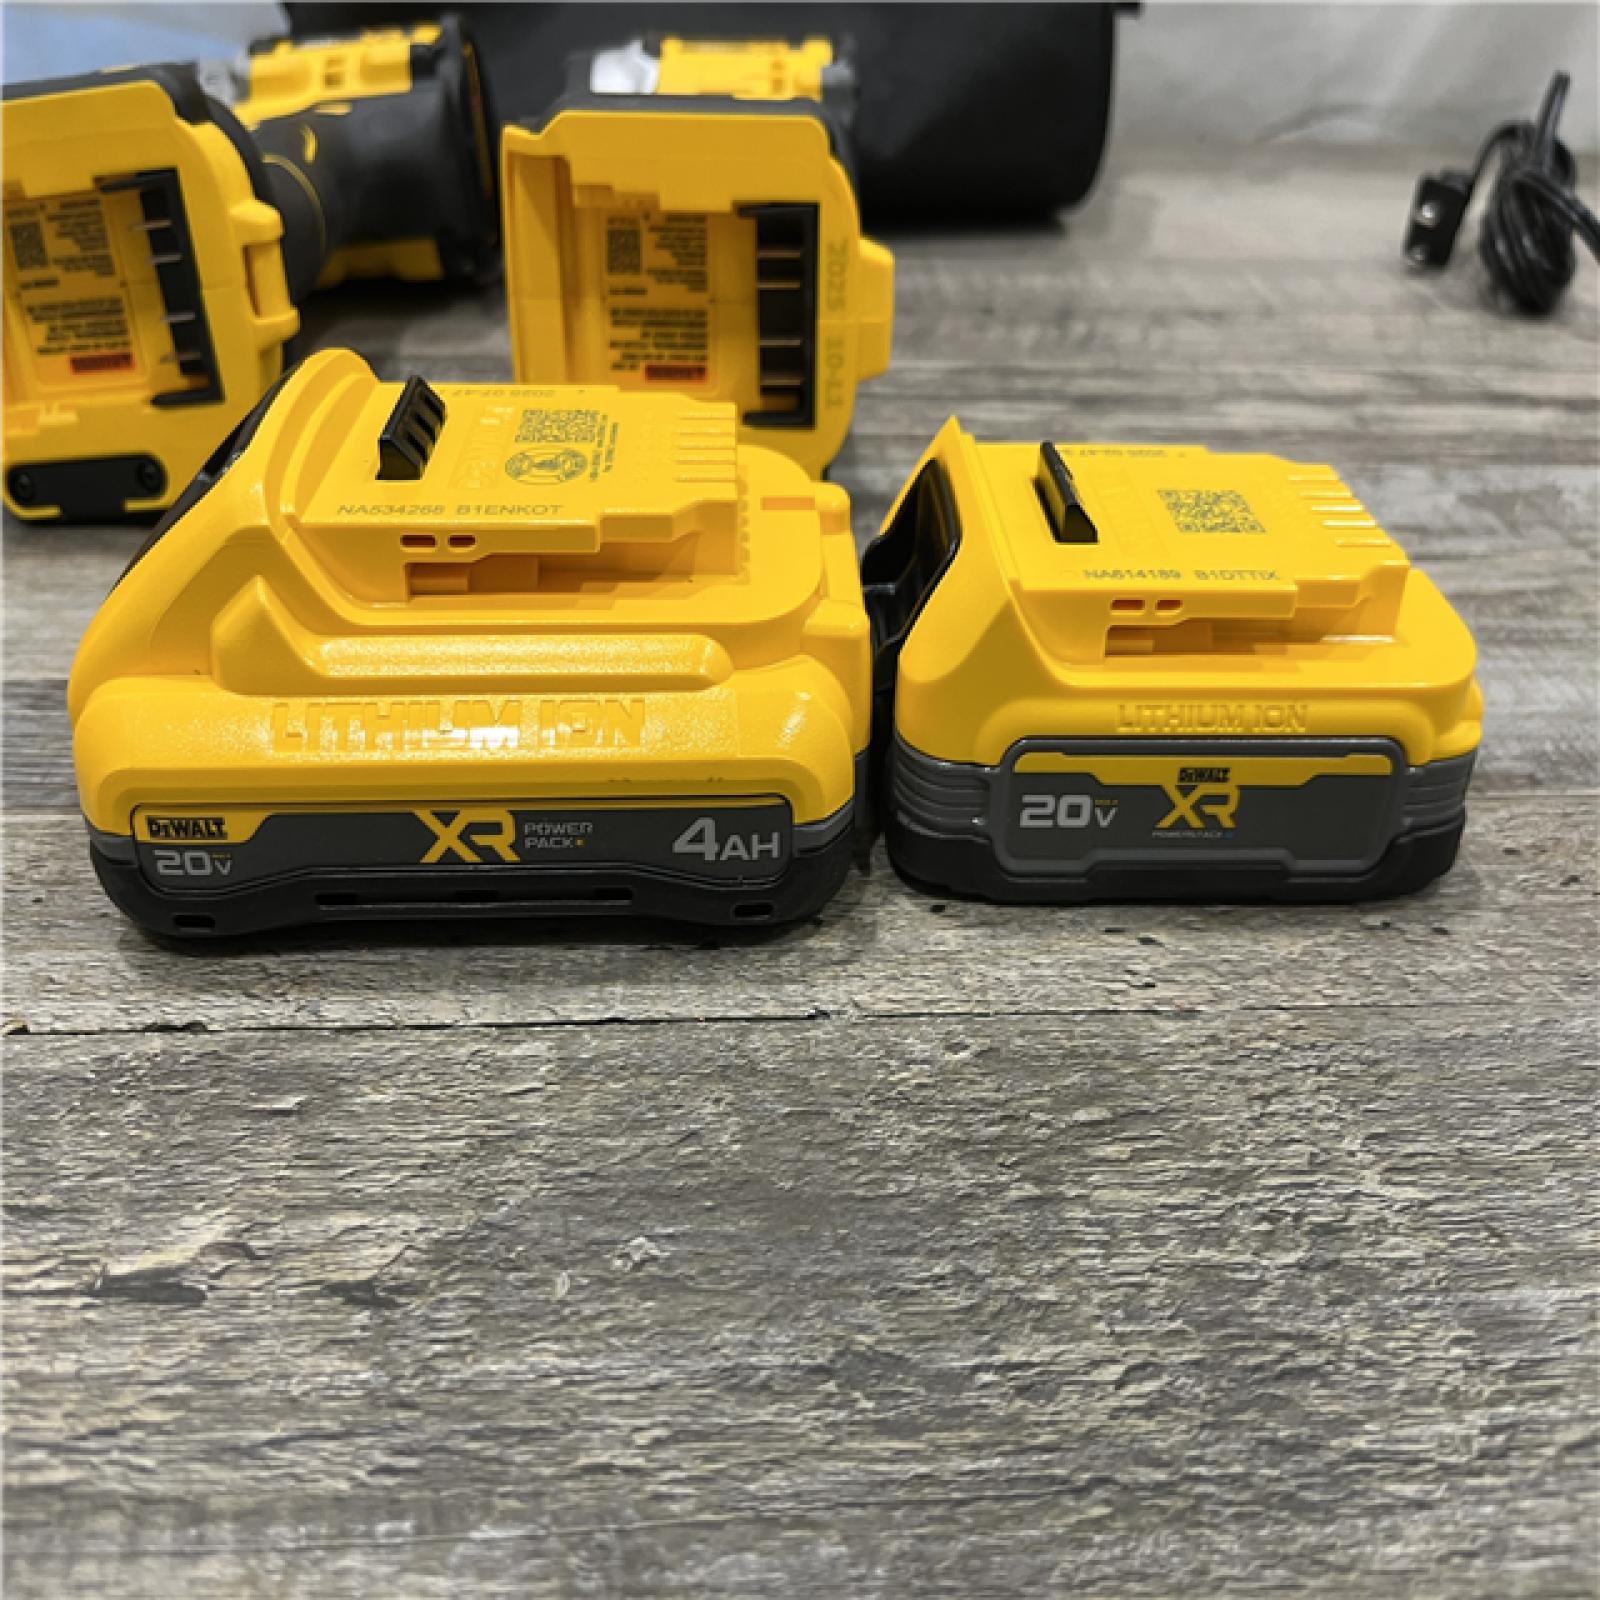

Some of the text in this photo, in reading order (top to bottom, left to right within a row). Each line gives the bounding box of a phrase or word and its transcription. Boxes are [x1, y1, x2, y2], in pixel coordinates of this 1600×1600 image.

[271, 698, 645, 752] LITHIUM ION
[1116, 704, 1308, 733] LITHIUM ION
[1154, 784, 1240, 829] XR
[412, 808, 521, 864] XR
[523, 822, 594, 837] POWER
[523, 836, 574, 850] PACK
[672, 817, 781, 862] 4AH
